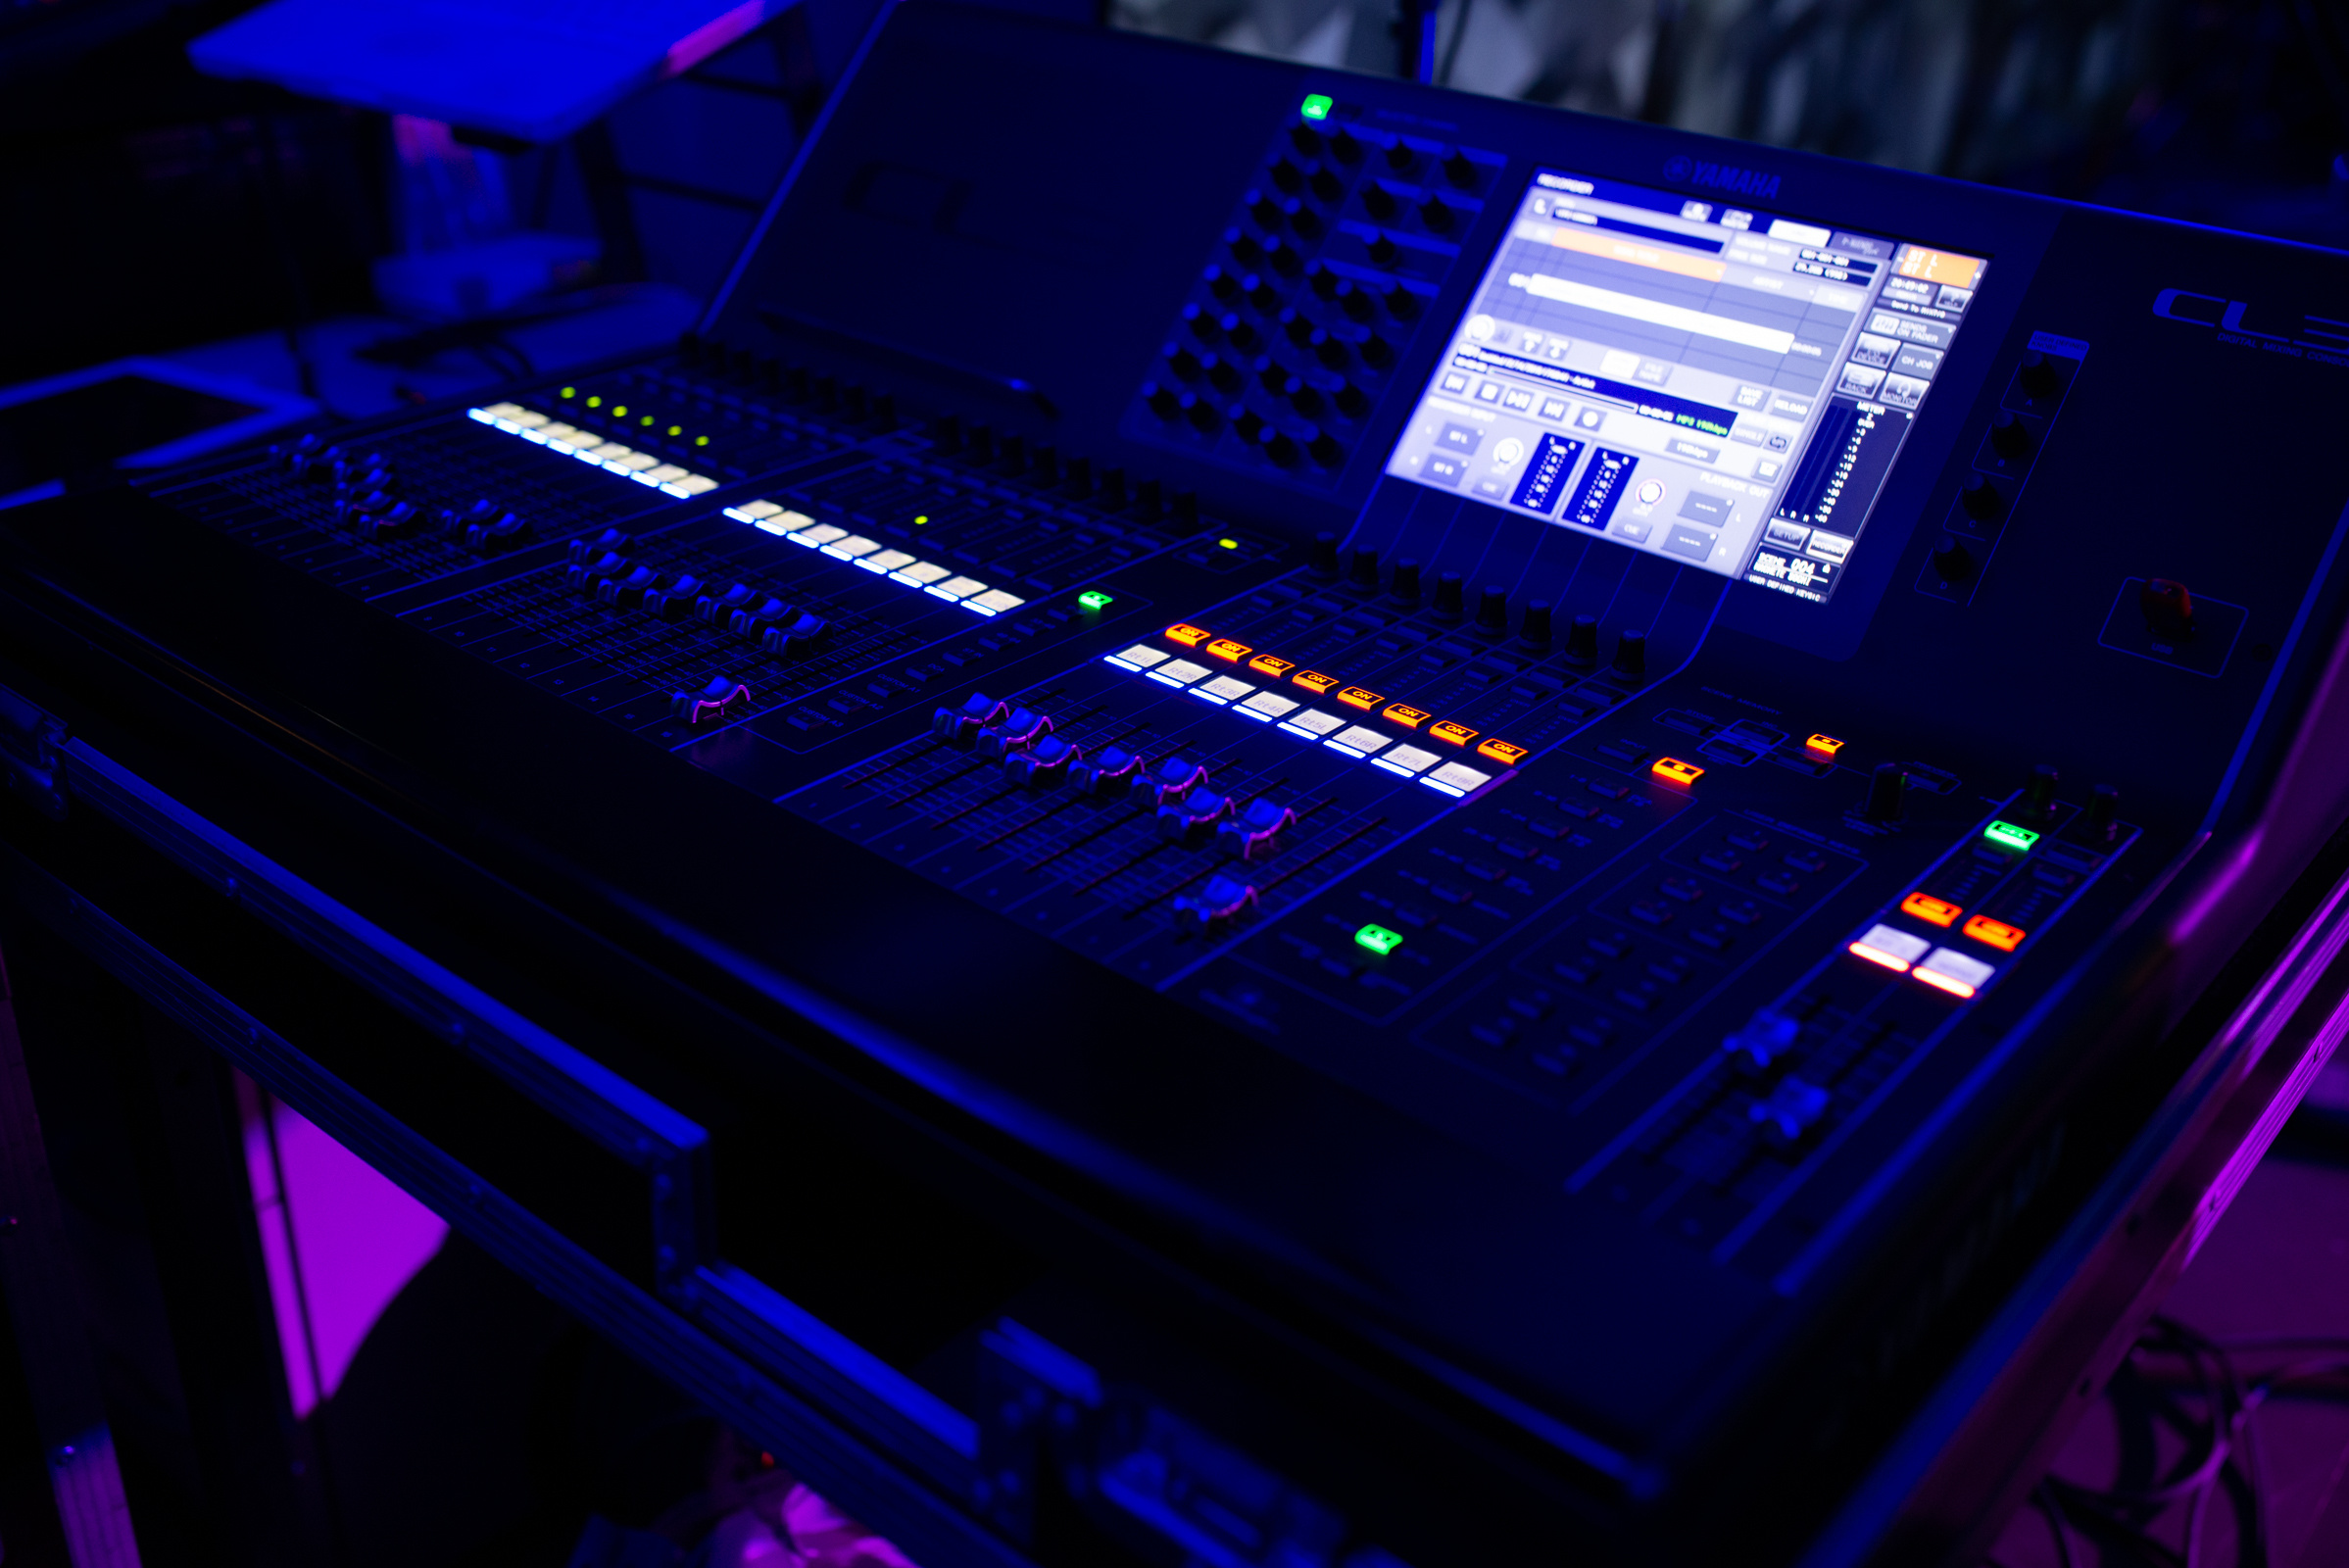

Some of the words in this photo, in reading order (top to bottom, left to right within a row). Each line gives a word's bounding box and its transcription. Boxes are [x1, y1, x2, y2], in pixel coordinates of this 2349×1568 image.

[1691, 160, 1782, 200] YAMAHA
[1910, 331, 1938, 344] FADER
[2034, 334, 2054, 343] USER
[2056, 339, 2087, 351] DEFINED
[2031, 341, 2057, 351] KNOBS
[2217, 332, 2258, 349] DIGITAL
[2263, 341, 2303, 358] MIXING
[1901, 355, 1915, 366] CH
[1916, 358, 1933, 370] JOB
[1883, 392, 1918, 407] MONITOR
[1856, 401, 1885, 416] METER
[1997, 459, 2006, 467] B
[1748, 483, 1770, 498] OUT
[1791, 559, 1815, 575] 004
[1180, 627, 1199, 637] ON
[1222, 642, 1241, 653] ON
[2151, 642, 2175, 656] USB
[1264, 658, 1283, 666] ON
[1168, 667, 1197, 680] Rt2R
[1307, 674, 1327, 683] ON
[877, 673, 908, 688] CUSTOM
[1211, 683, 1240, 697] Rt3R
[1352, 690, 1372, 700] ON
[838, 689, 870, 705] CUSTOM
[1509, 698, 1531, 708] OVER
[1701, 685, 1735, 700] SCENE
[1737, 698, 1784, 715] MEMORY
[1254, 700, 1284, 713] Rt4R
[1398, 708, 1418, 717] ON
[798, 706, 830, 721] CUSTOM
[1557, 714, 1580, 725] OVER
[1686, 709, 1716, 721] STORE
[1300, 716, 1327, 731] Rt5L
[1445, 724, 1465, 735] ON
[1761, 720, 1779, 729] INC
[1346, 734, 1377, 749] Rt6R
[1620, 738, 1647, 750] INPUT
[1493, 743, 1514, 754] ON
[1394, 753, 1422, 766] Rt7L
[1707, 757, 1727, 765] DEC
